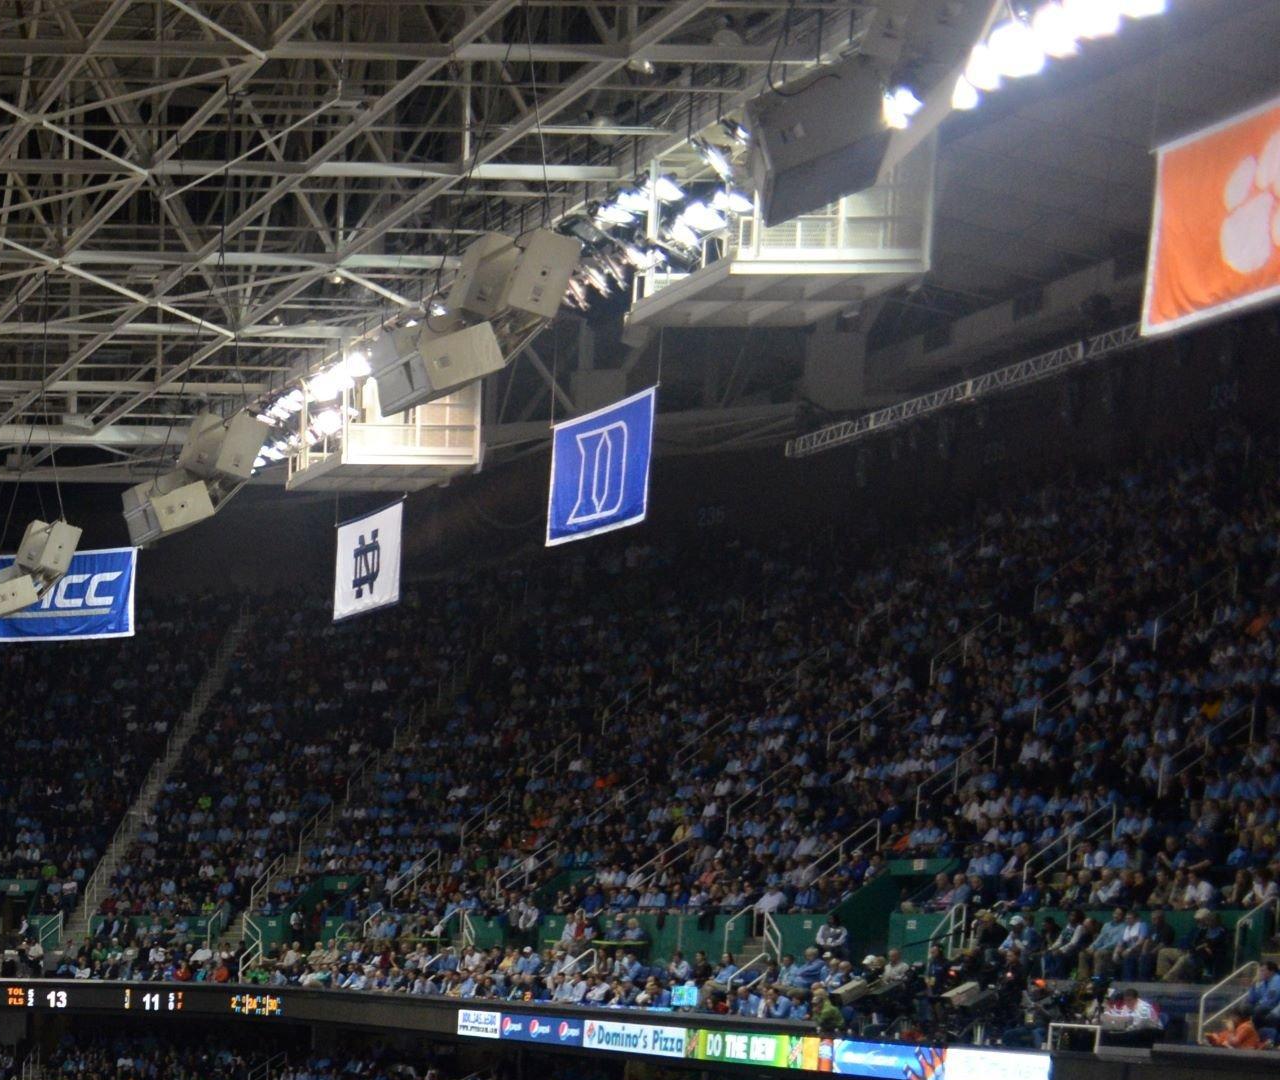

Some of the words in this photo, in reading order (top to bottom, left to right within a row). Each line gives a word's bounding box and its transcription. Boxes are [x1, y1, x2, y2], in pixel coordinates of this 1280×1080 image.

[8, 987, 25, 996] TOL
[46, 990, 67, 1008] 13
[8, 997, 24, 1005] FLS
[142, 993, 160, 1010] 11
[597, 1024, 648, 1050] Domino's
[652, 1029, 684, 1051] Pizza
[705, 1032, 722, 1057] DO
[724, 1033, 748, 1060] THE
